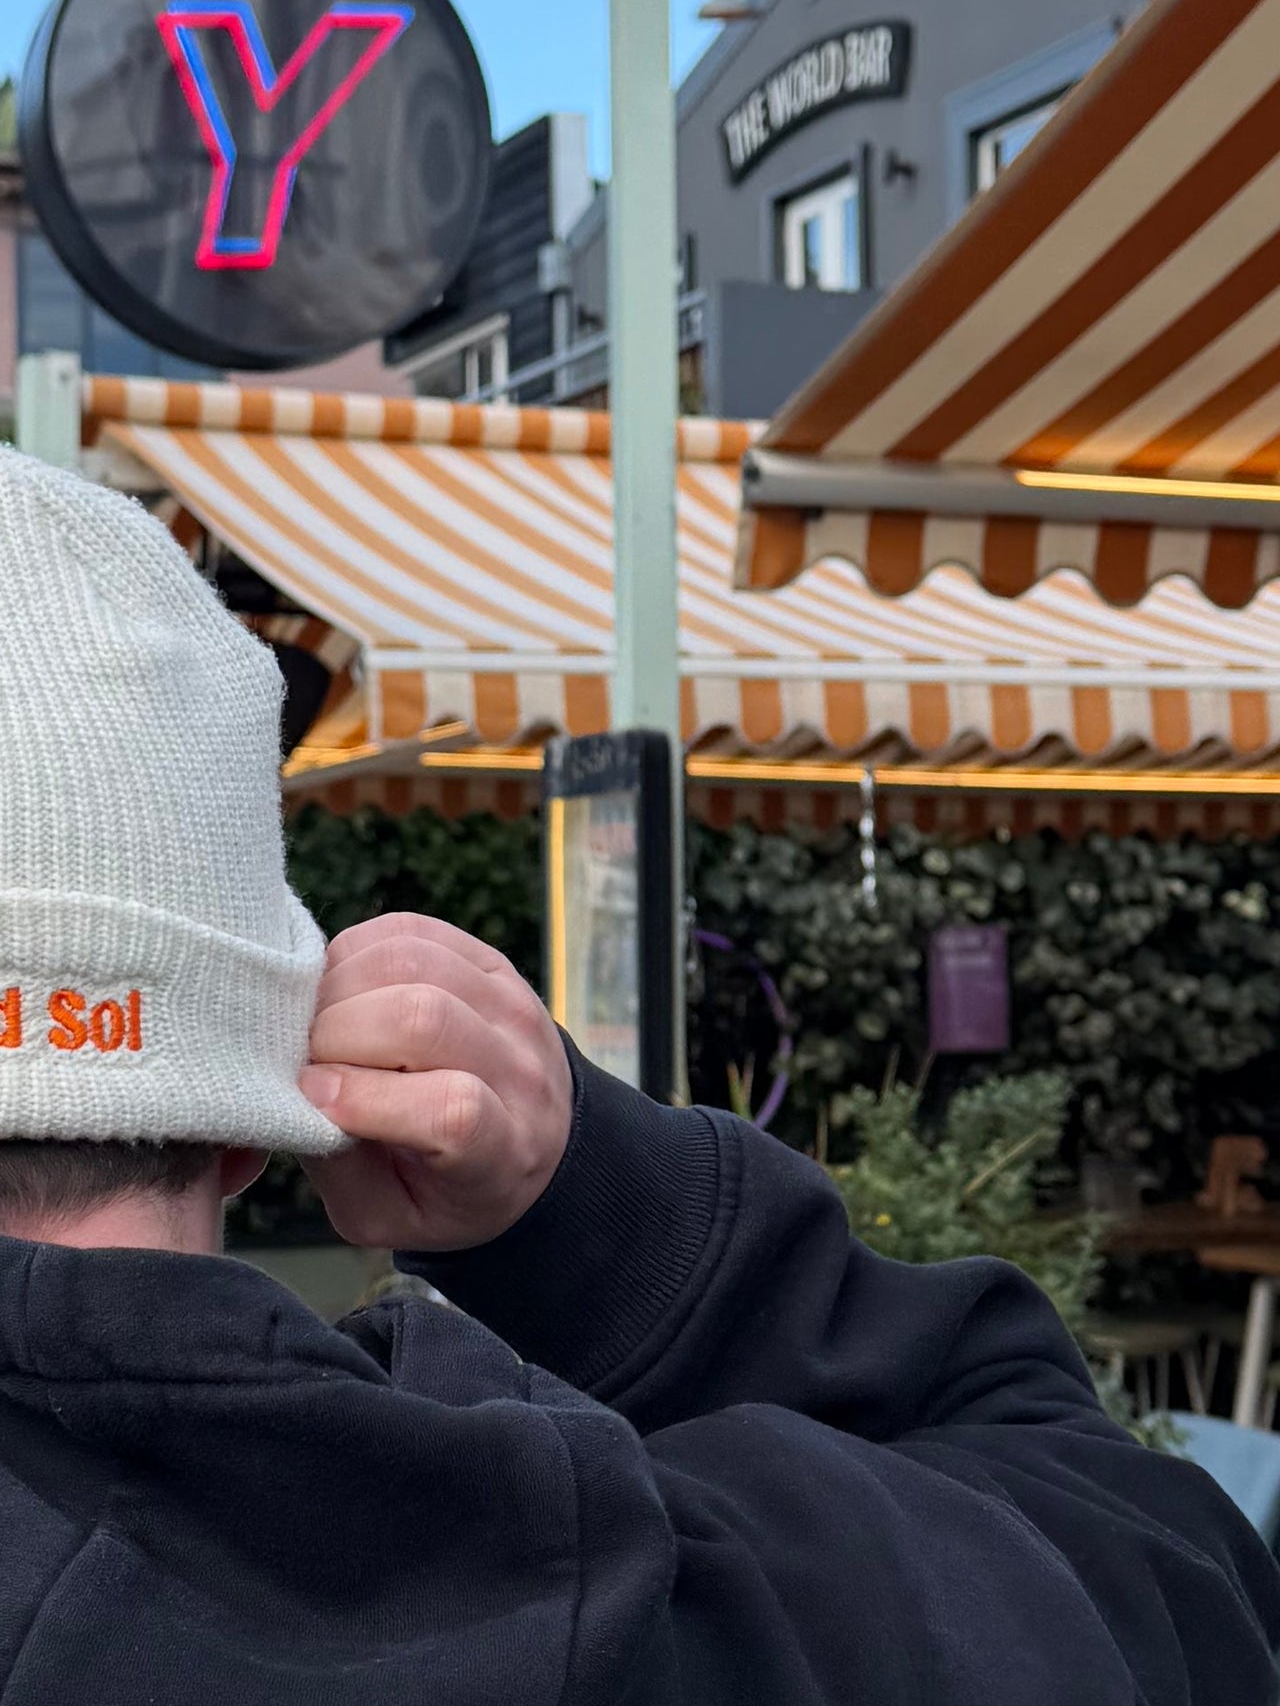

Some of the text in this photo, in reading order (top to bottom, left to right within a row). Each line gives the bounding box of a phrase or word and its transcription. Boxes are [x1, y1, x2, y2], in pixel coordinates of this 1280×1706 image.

[725, 25, 893, 169] THE WORLD BAR
[47, 988, 143, 1052] Sol
